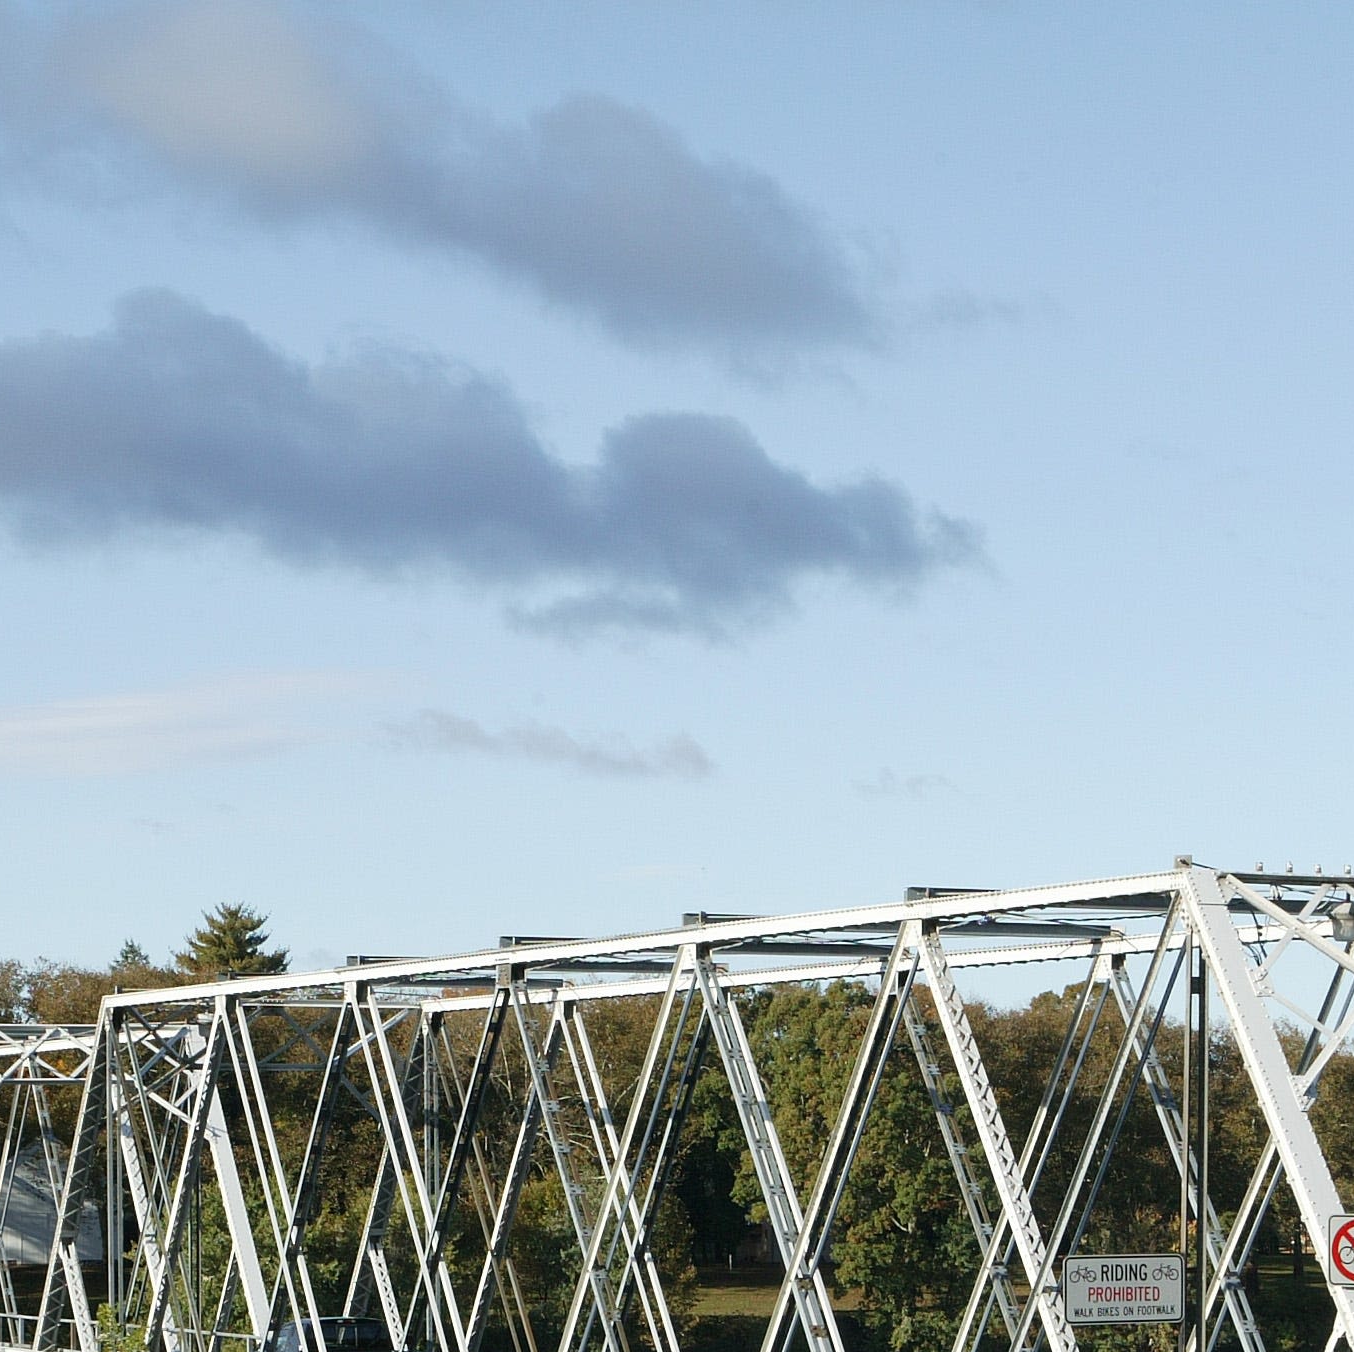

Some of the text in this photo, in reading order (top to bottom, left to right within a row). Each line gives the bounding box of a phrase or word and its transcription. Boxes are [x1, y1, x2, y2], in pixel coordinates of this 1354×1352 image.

[1101, 1264, 1148, 1282] RIDING
[1088, 1286, 1160, 1302] PROHIBITED
[1074, 1305, 1175, 1317] WALK BIKES ON FOOTWALK
